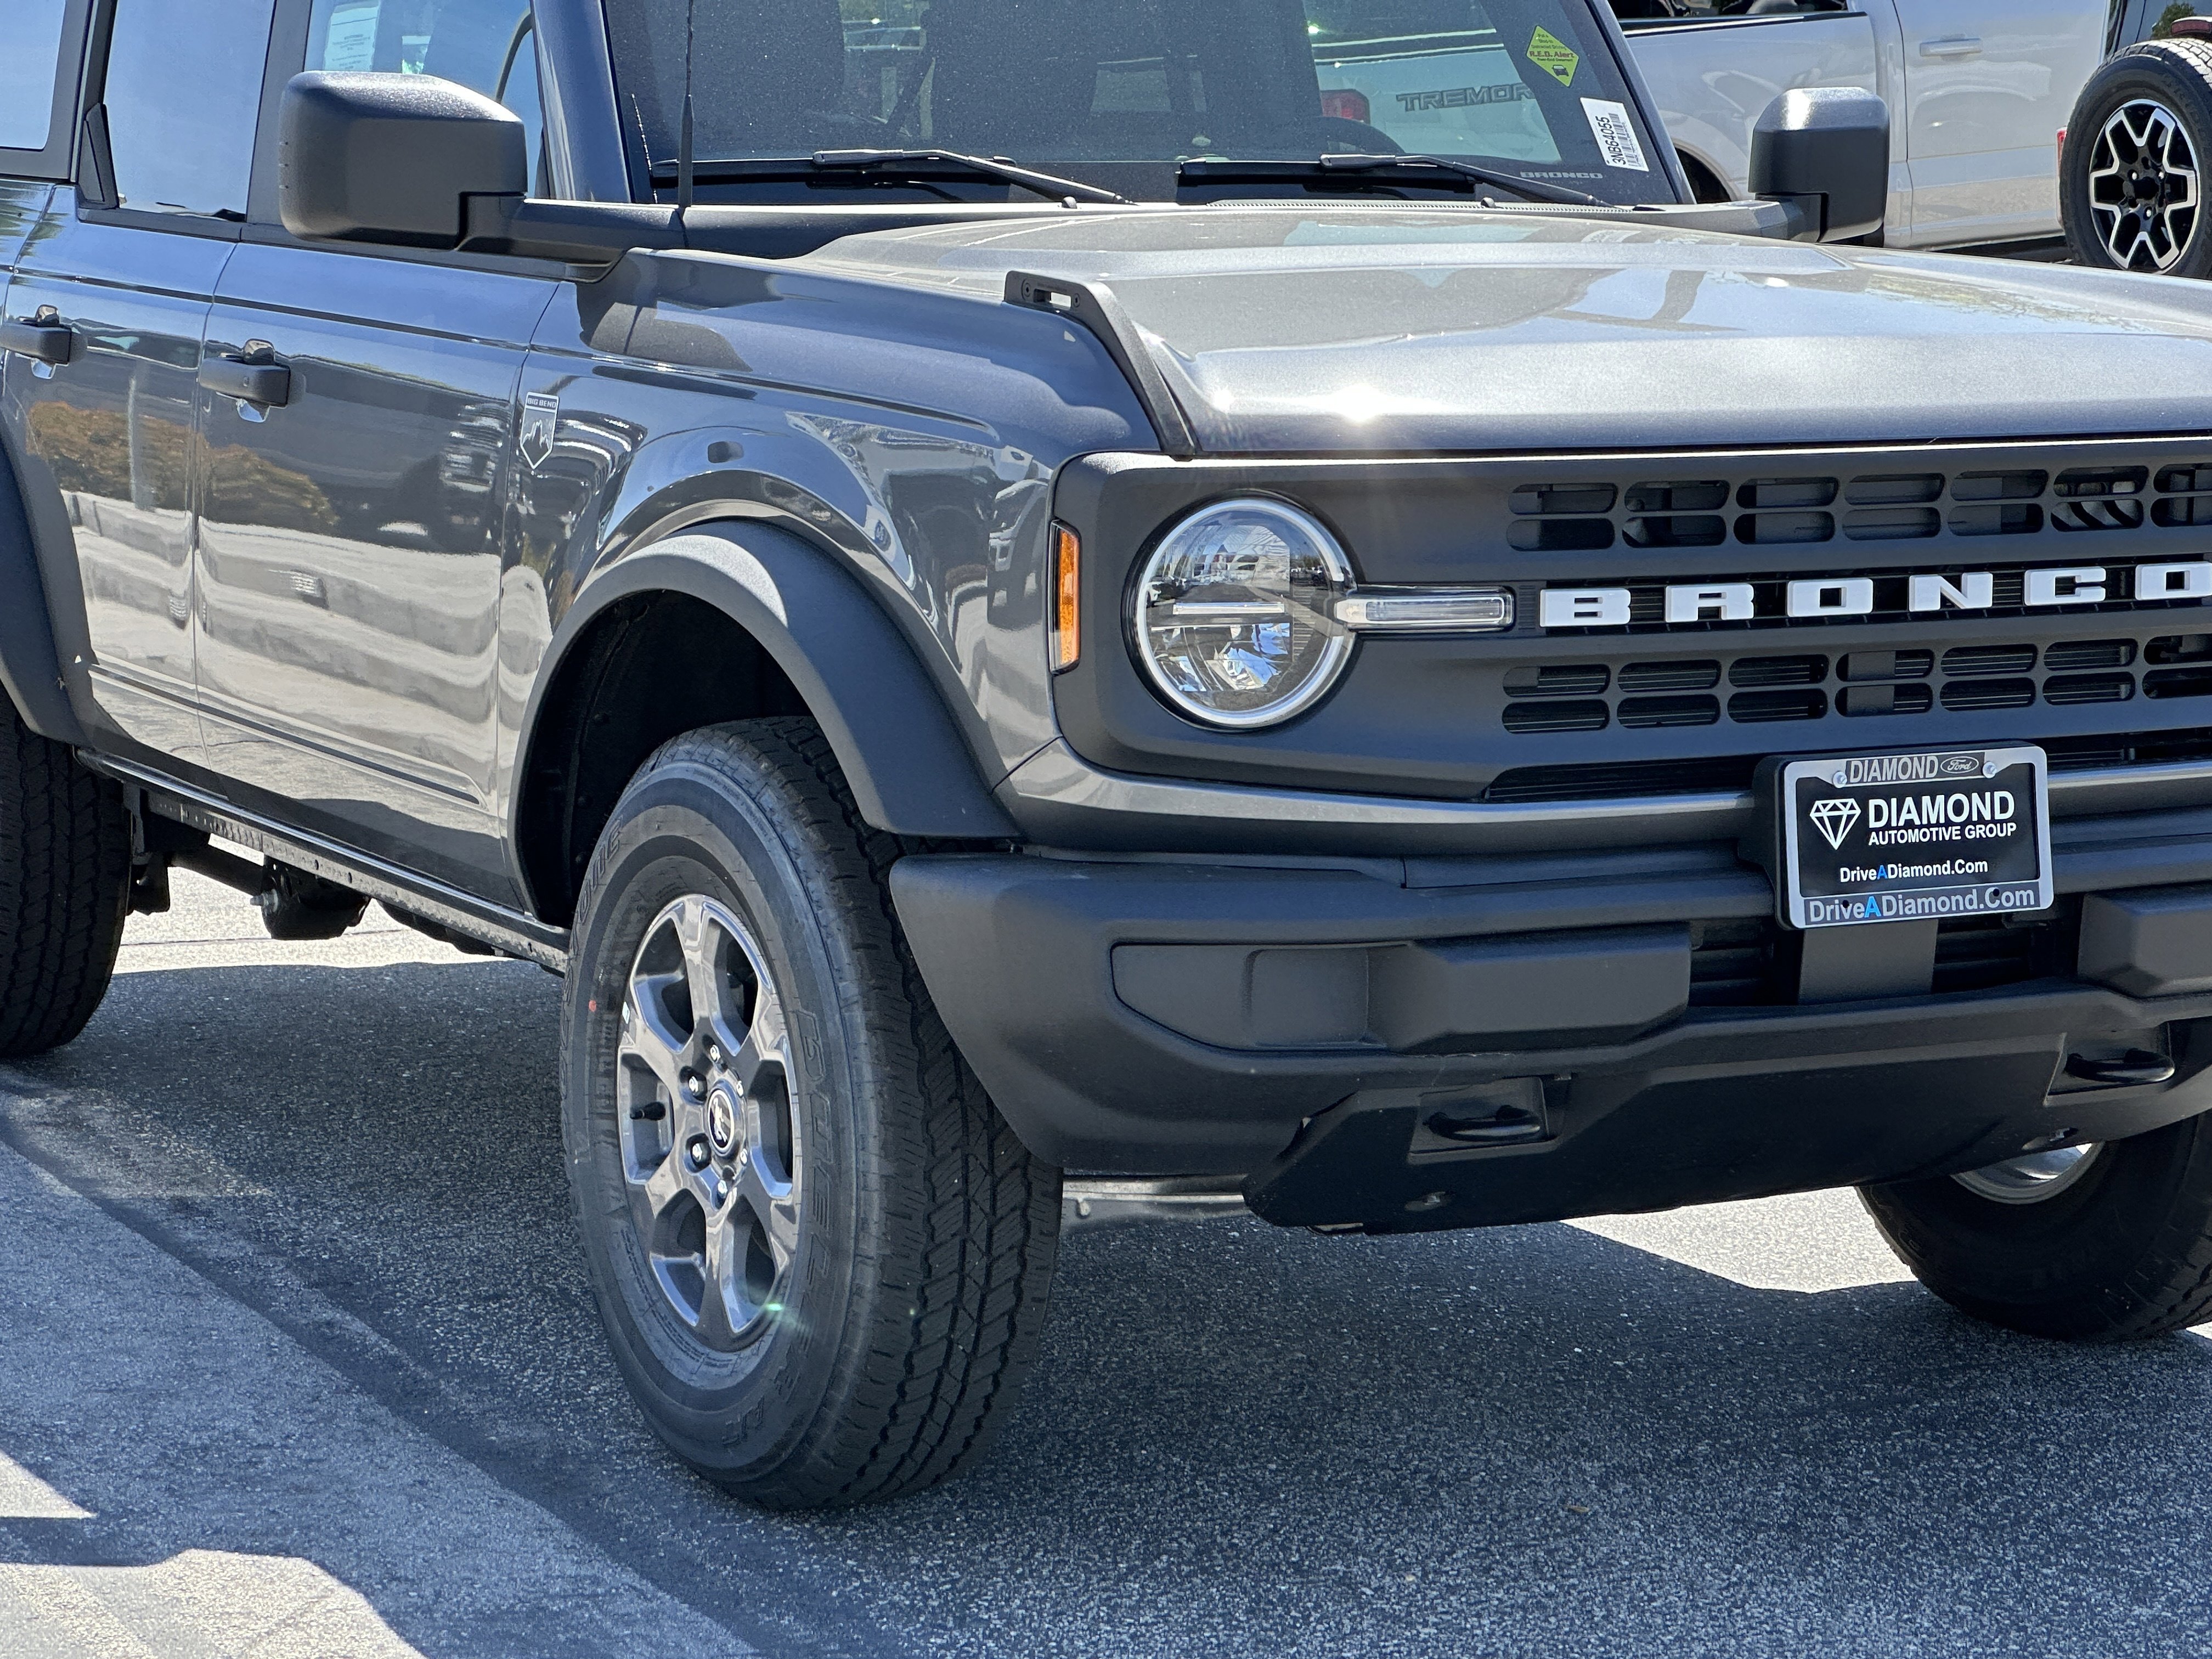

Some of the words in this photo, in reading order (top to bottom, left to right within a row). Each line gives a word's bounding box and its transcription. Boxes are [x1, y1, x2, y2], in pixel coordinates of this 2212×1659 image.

[1396, 82, 1536, 112] TREMOR
[1595, 116, 1627, 165] 3NB64055
[539, 399, 557, 408] BEND
[1539, 561, 2212, 628] BRONCO
[1850, 755, 1939, 783] DIAMOND
[1947, 758, 1972, 772] Ford
[1869, 791, 2015, 827] DIAMOND
[1869, 828, 1961, 845] AUTOMOTIVE
[1965, 822, 2017, 839] GROUP
[1840, 860, 1988, 882] DriveADiamond.Com
[1809, 888, 2034, 922] DriveADiamond.Com
